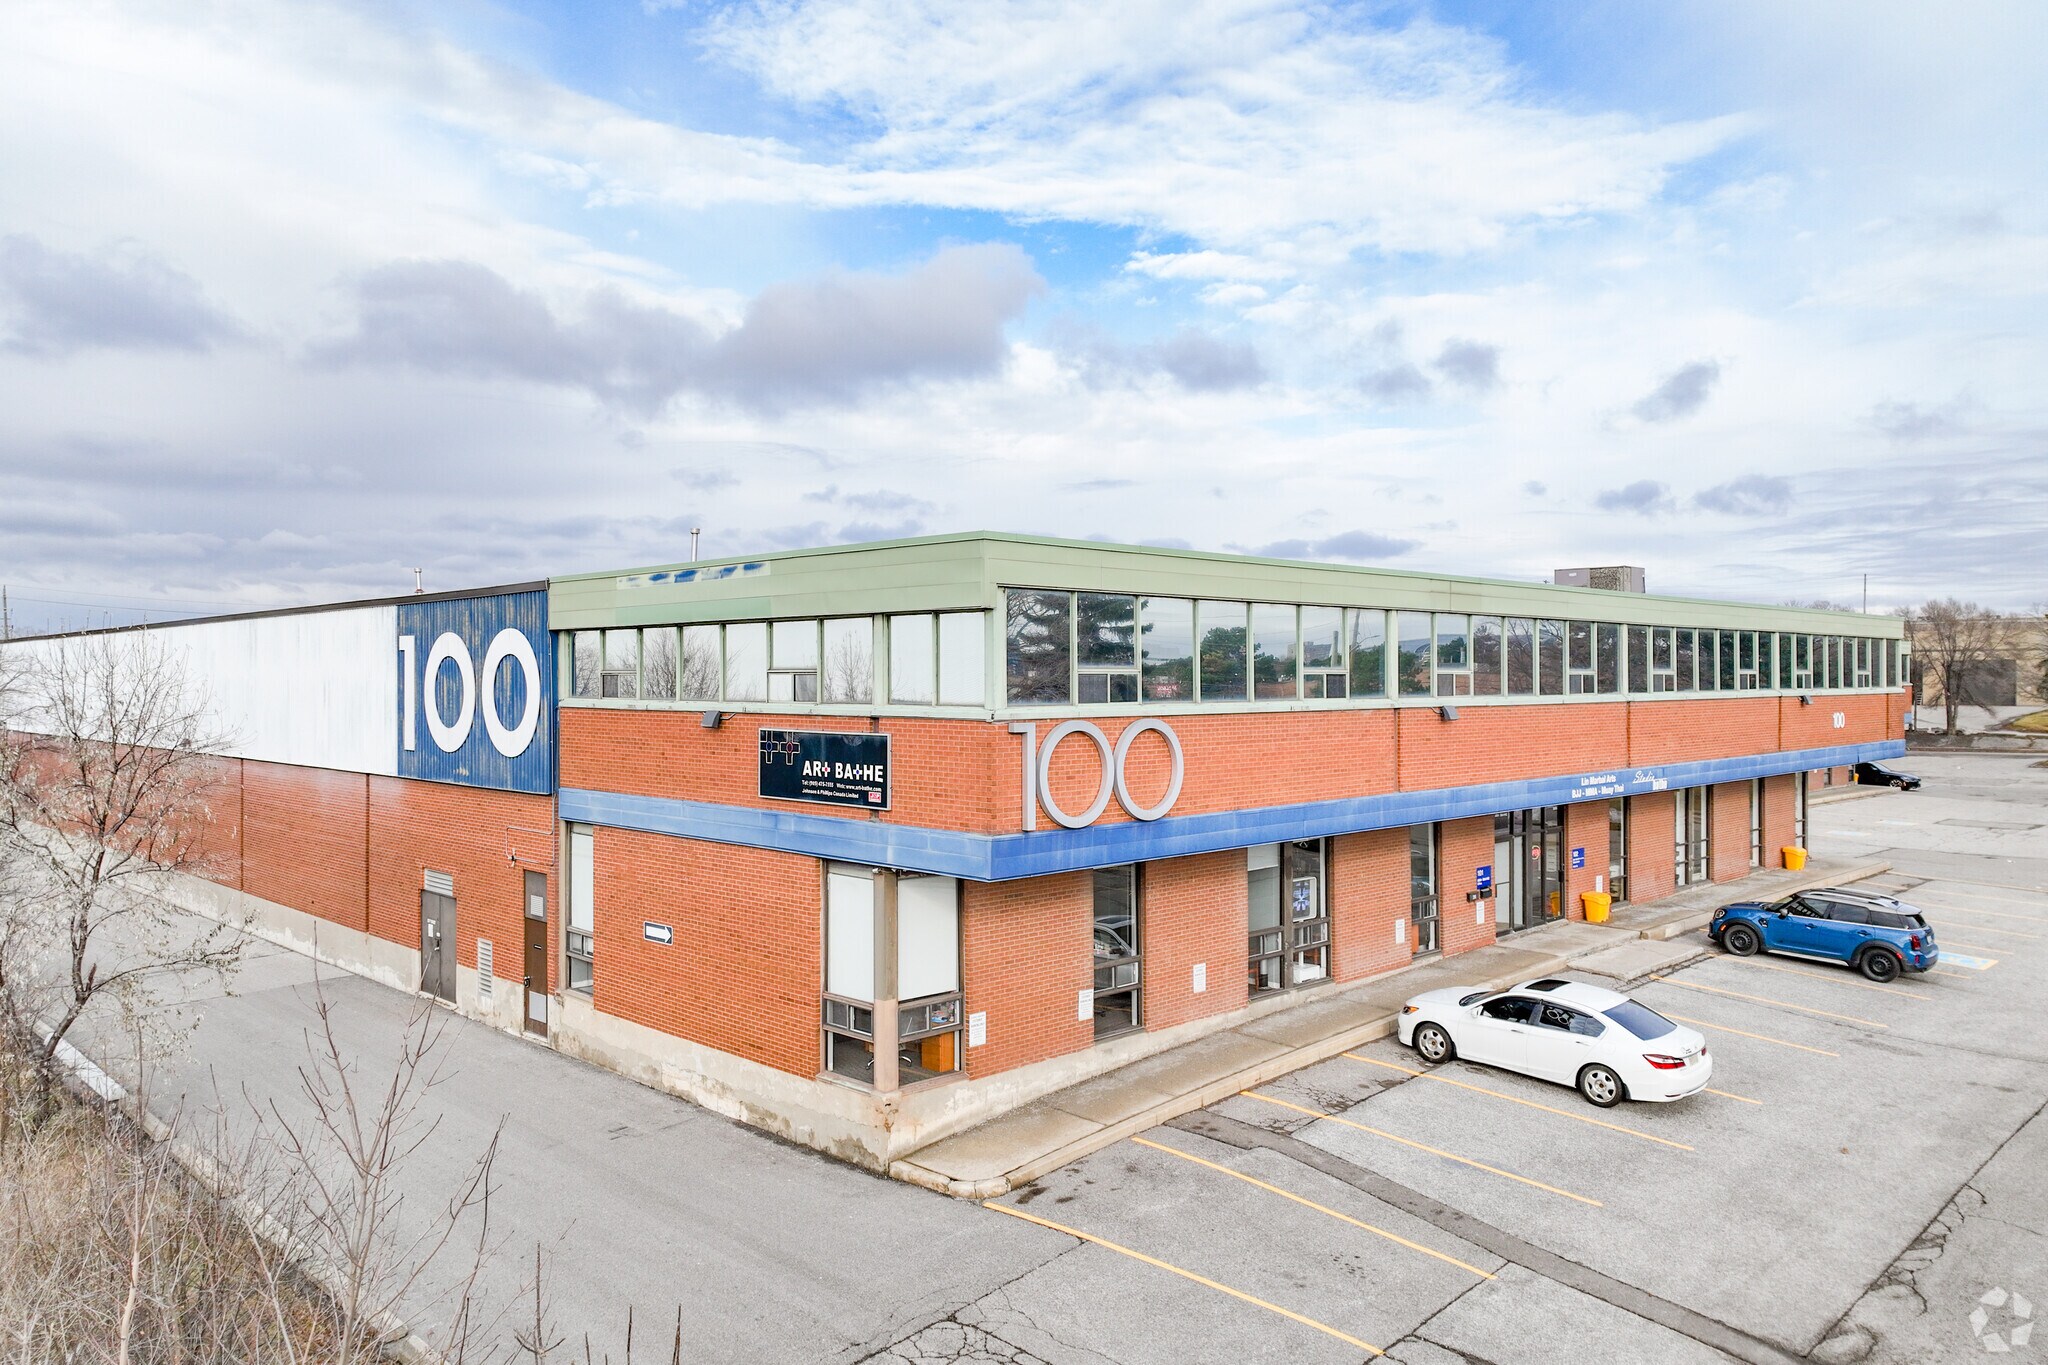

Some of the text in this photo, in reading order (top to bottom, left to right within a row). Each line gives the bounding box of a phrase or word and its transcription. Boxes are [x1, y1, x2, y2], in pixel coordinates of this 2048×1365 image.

[399, 627, 541, 758] 100
[1833, 712, 1845, 729] 100
[1008, 718, 1184, 831] 100
[1606, 774, 1617, 783] Arts
[1571, 789, 1581, 798] BJJ
